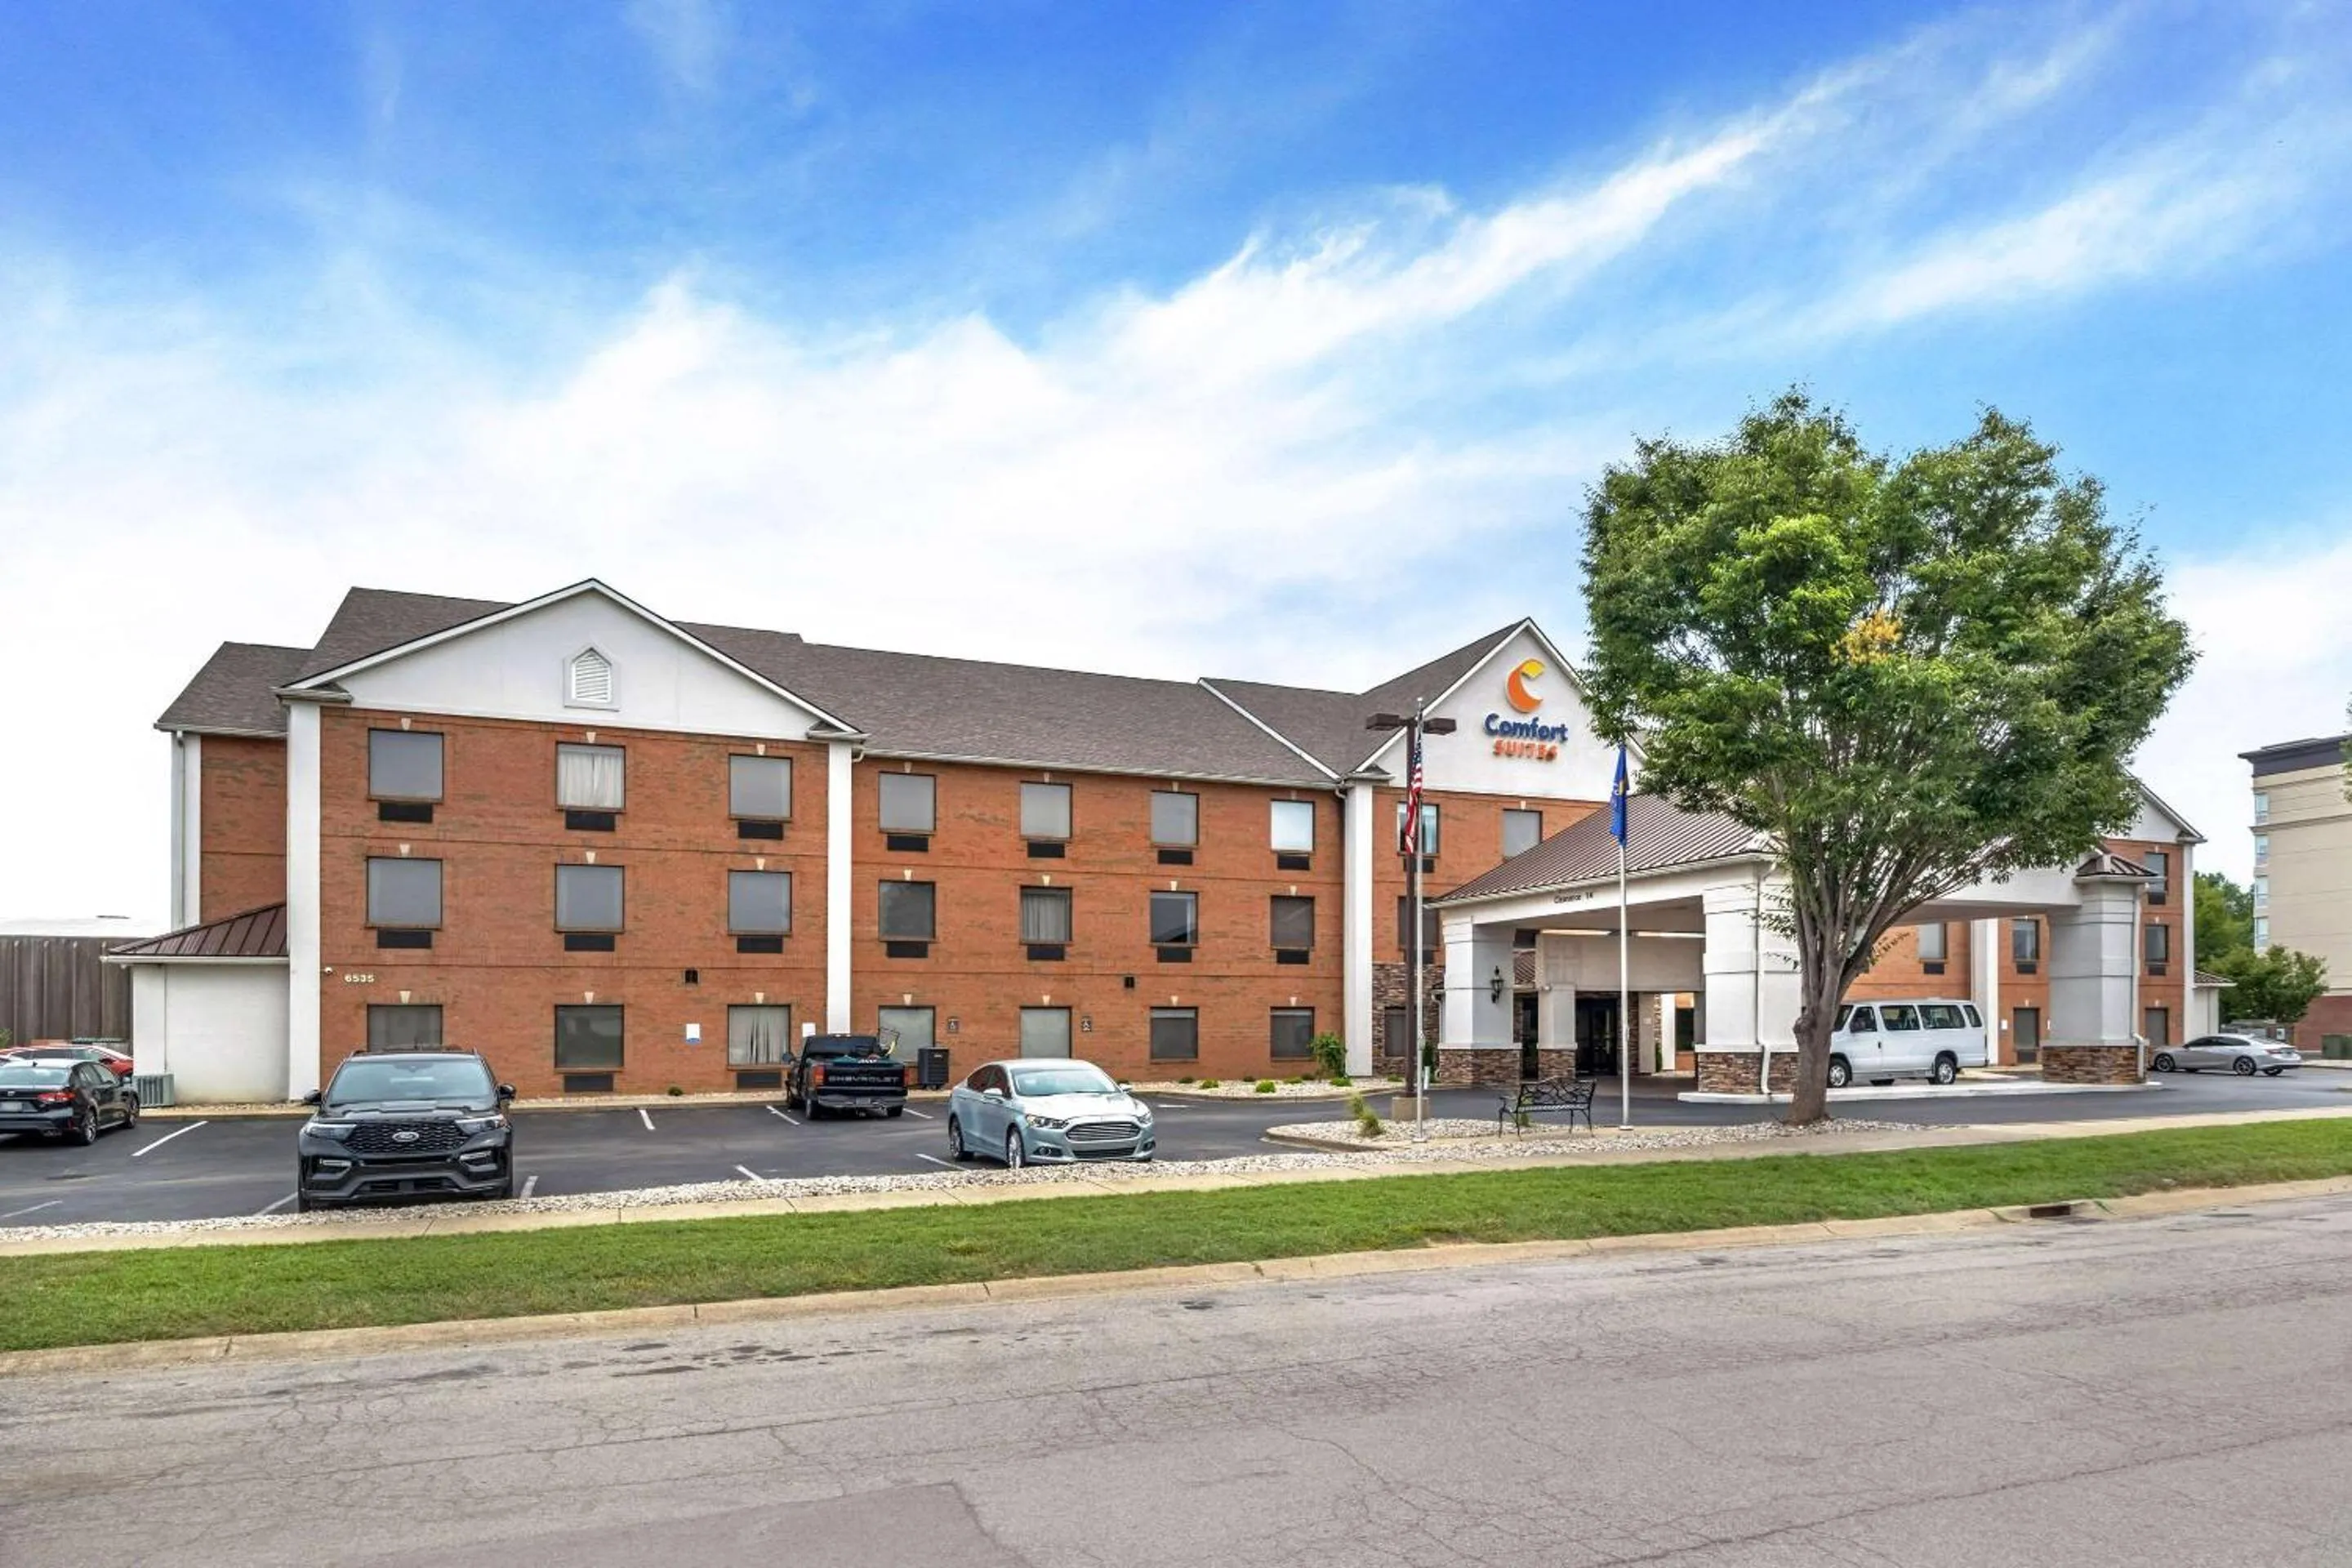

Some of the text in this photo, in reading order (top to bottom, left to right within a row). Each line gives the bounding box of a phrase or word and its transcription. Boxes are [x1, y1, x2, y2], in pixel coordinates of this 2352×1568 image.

[1485, 713, 1568, 742] Comfort
[1493, 739, 1557, 761] SUITES
[345, 973, 375, 982] 6535
